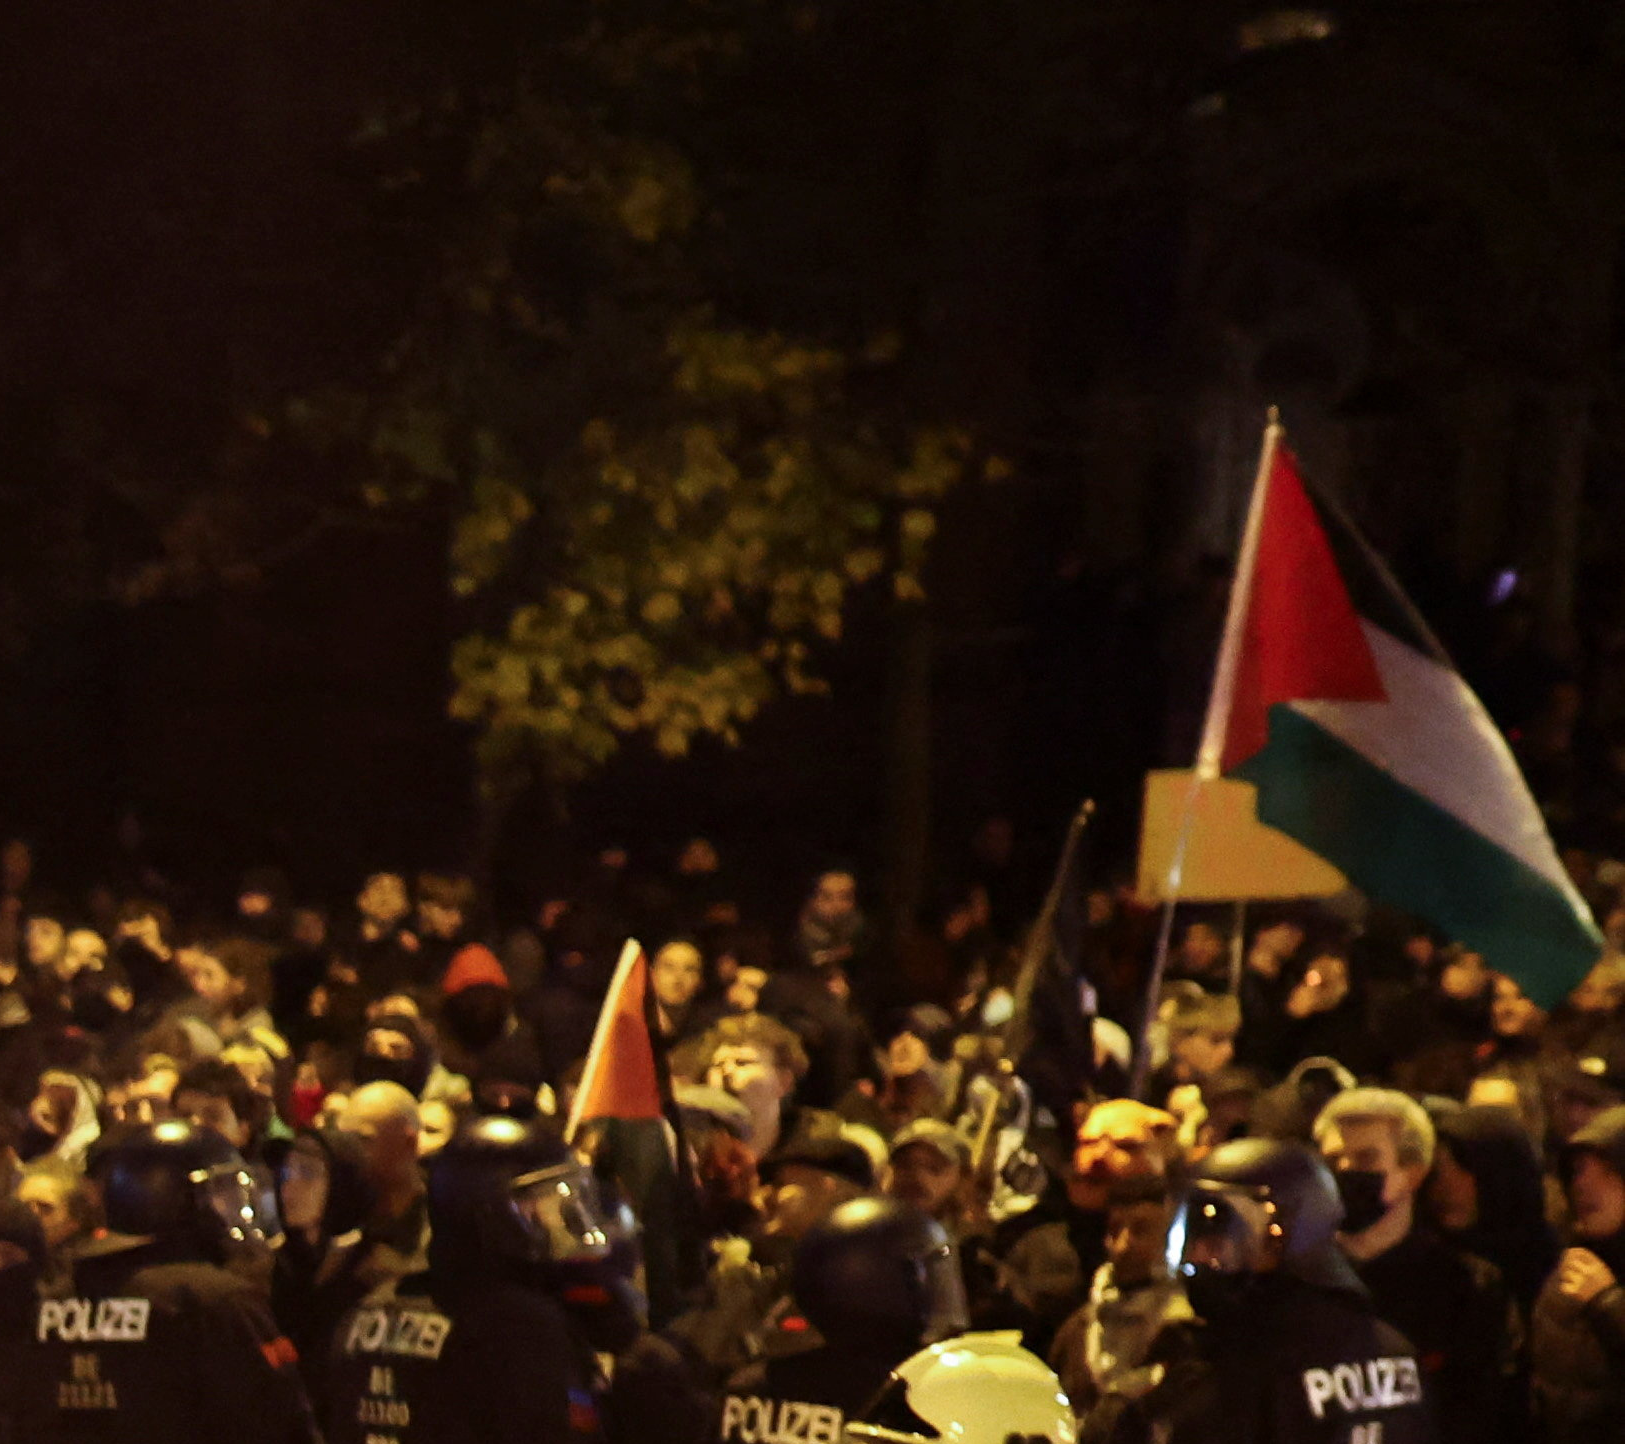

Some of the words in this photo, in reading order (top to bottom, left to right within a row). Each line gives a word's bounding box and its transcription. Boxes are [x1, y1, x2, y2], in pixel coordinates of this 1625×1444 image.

[38, 1297, 151, 1343] POLIZEI
[345, 1308, 454, 1360] POLIZEI
[1302, 1356, 1423, 1420] POLIZEI
